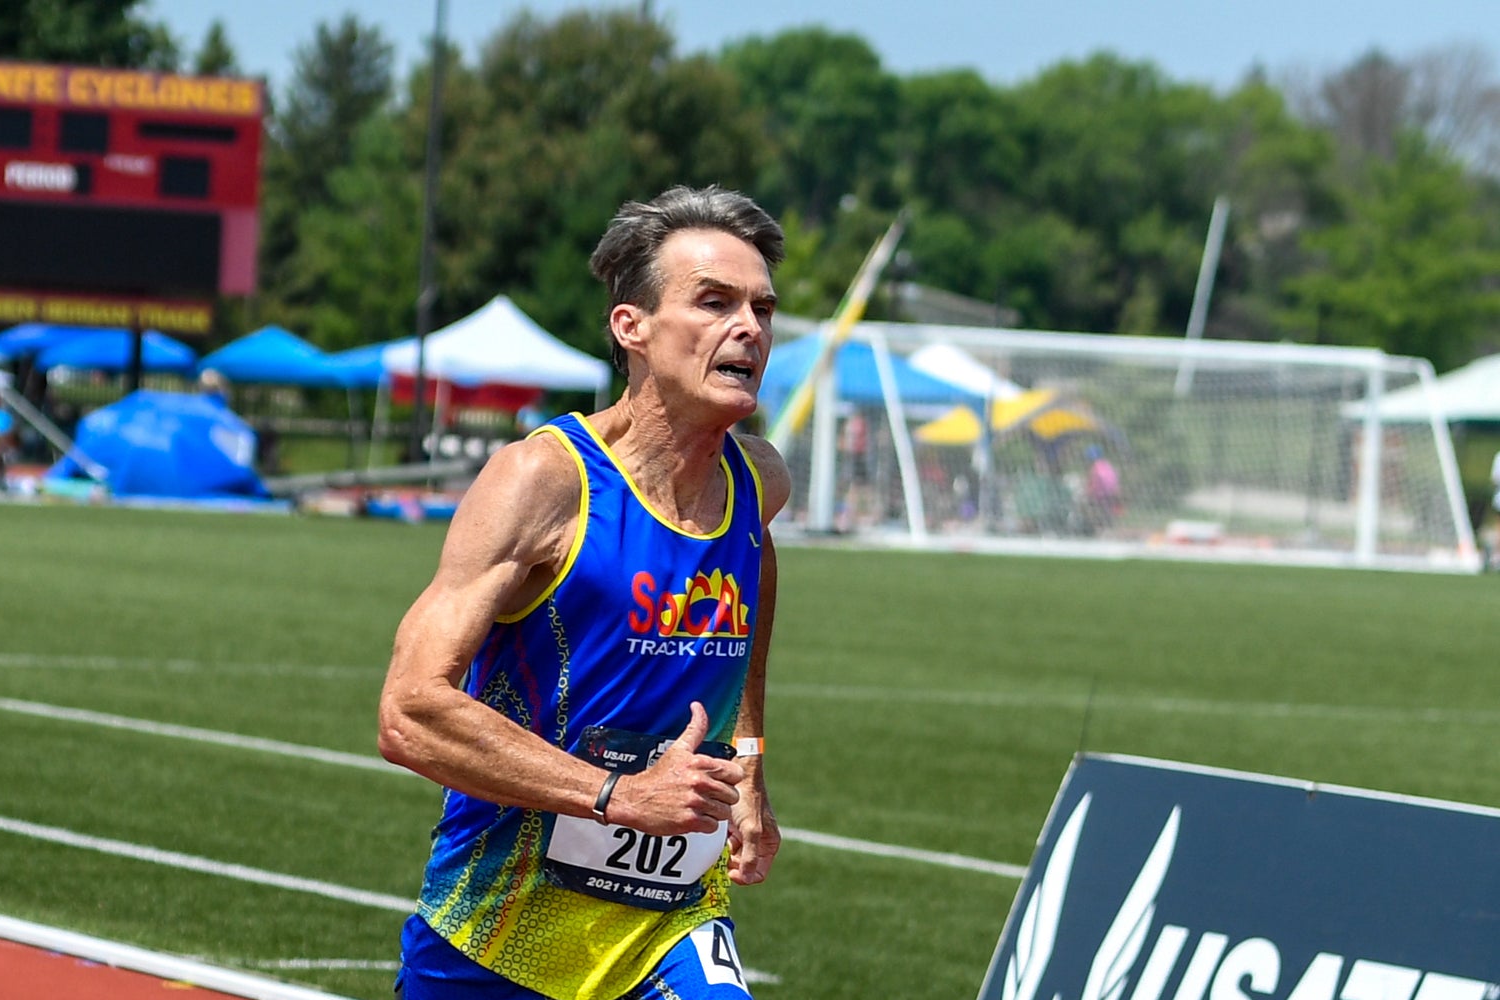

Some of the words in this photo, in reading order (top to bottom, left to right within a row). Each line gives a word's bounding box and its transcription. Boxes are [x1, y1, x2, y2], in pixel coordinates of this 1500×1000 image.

[626, 638, 697, 656] TRACK
[702, 641, 746, 657] CLUB
[603, 749, 638, 764] USATF
[605, 827, 688, 878] 202
[586, 877, 620, 893] 2021
[633, 886, 672, 903] AMES,
[711, 922, 743, 986] 4
